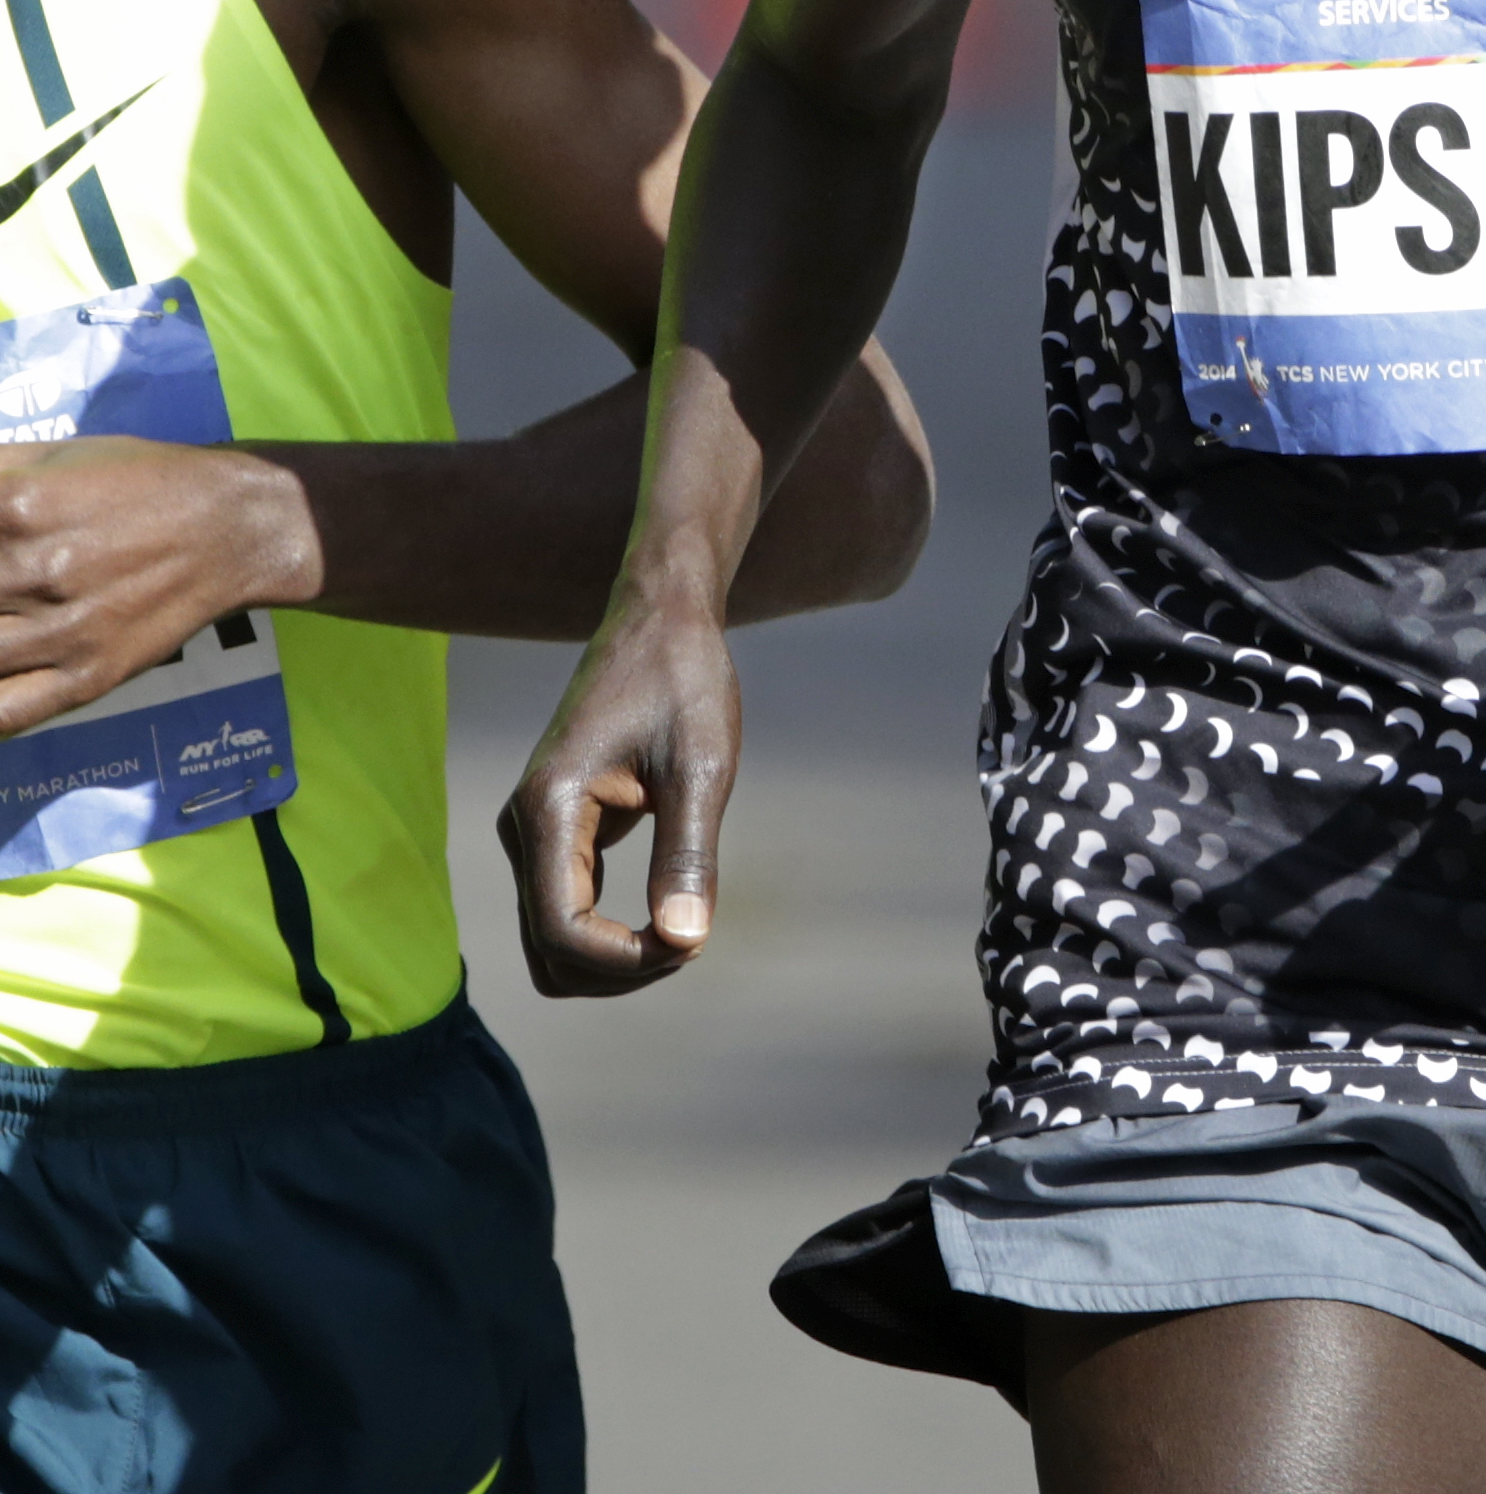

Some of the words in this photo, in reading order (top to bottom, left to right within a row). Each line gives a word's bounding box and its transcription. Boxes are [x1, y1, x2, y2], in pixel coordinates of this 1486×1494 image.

[1197, 363, 1237, 381] 2014
[1276, 365, 1314, 383] TCS
[1319, 364, 1370, 383] NEW
[1377, 360, 1441, 381] YORK
[17, 756, 141, 803] MARATHON
